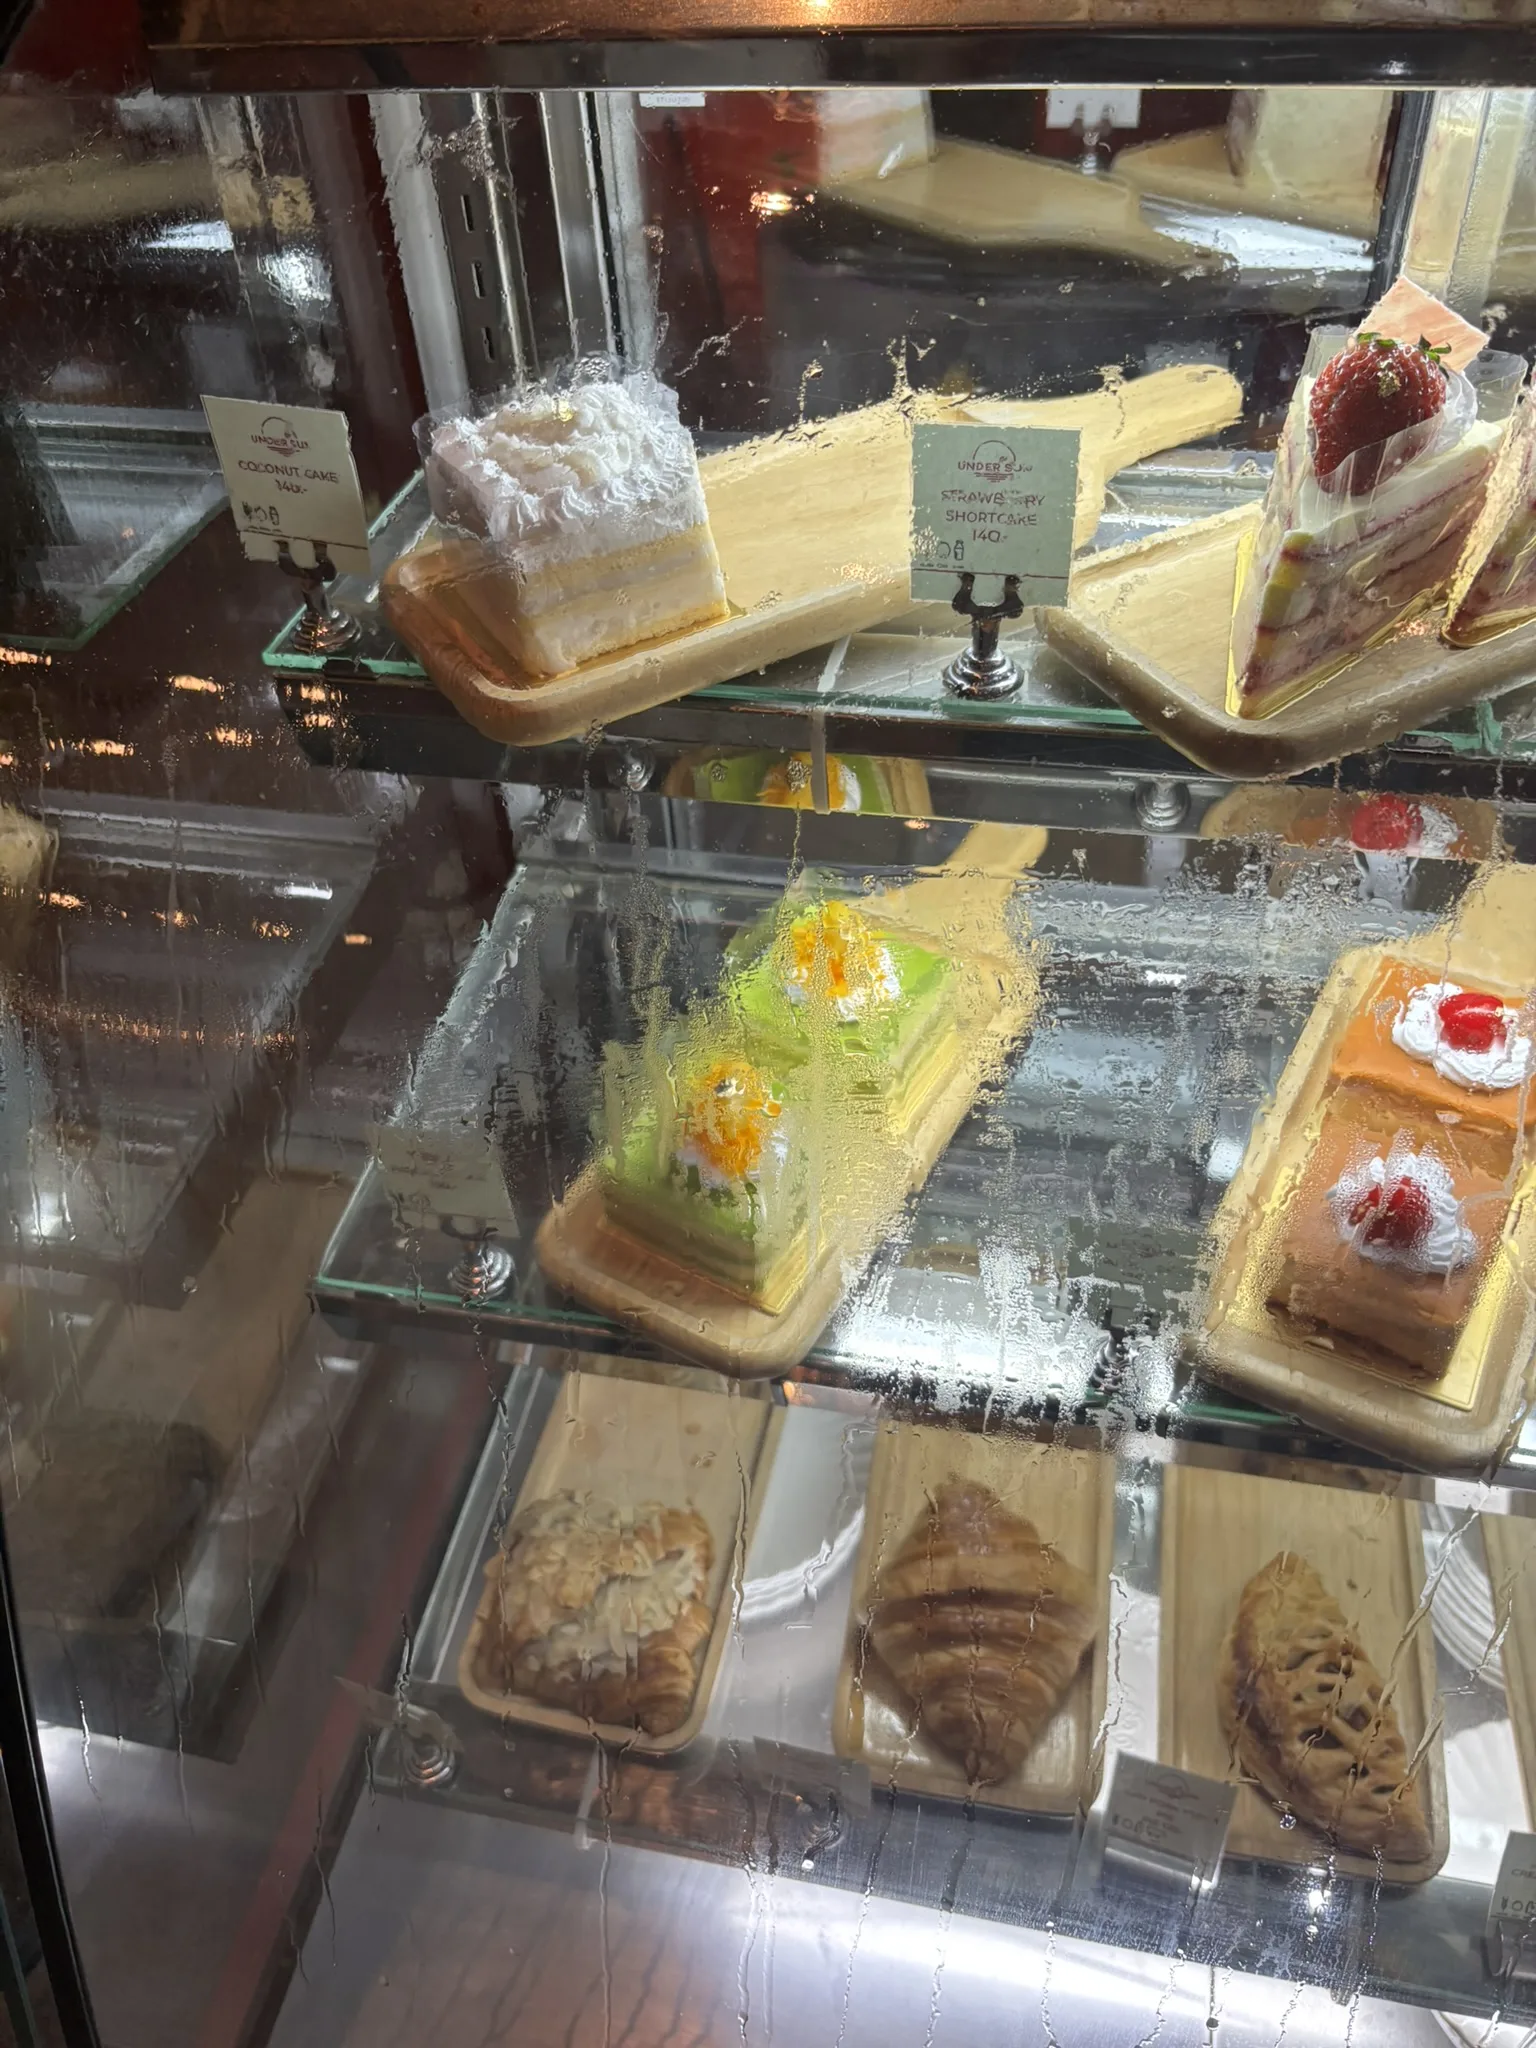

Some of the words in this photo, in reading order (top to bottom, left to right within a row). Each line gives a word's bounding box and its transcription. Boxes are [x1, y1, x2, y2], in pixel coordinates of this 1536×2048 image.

[251, 434, 287, 446] UNDER
[238, 460, 300, 477] COCONUT
[304, 469, 339, 484] CAKE
[958, 461, 1000, 472] UNDER
[941, 489, 1046, 508] STRAWBRY
[946, 510, 1037, 526] SHORTCAKE
